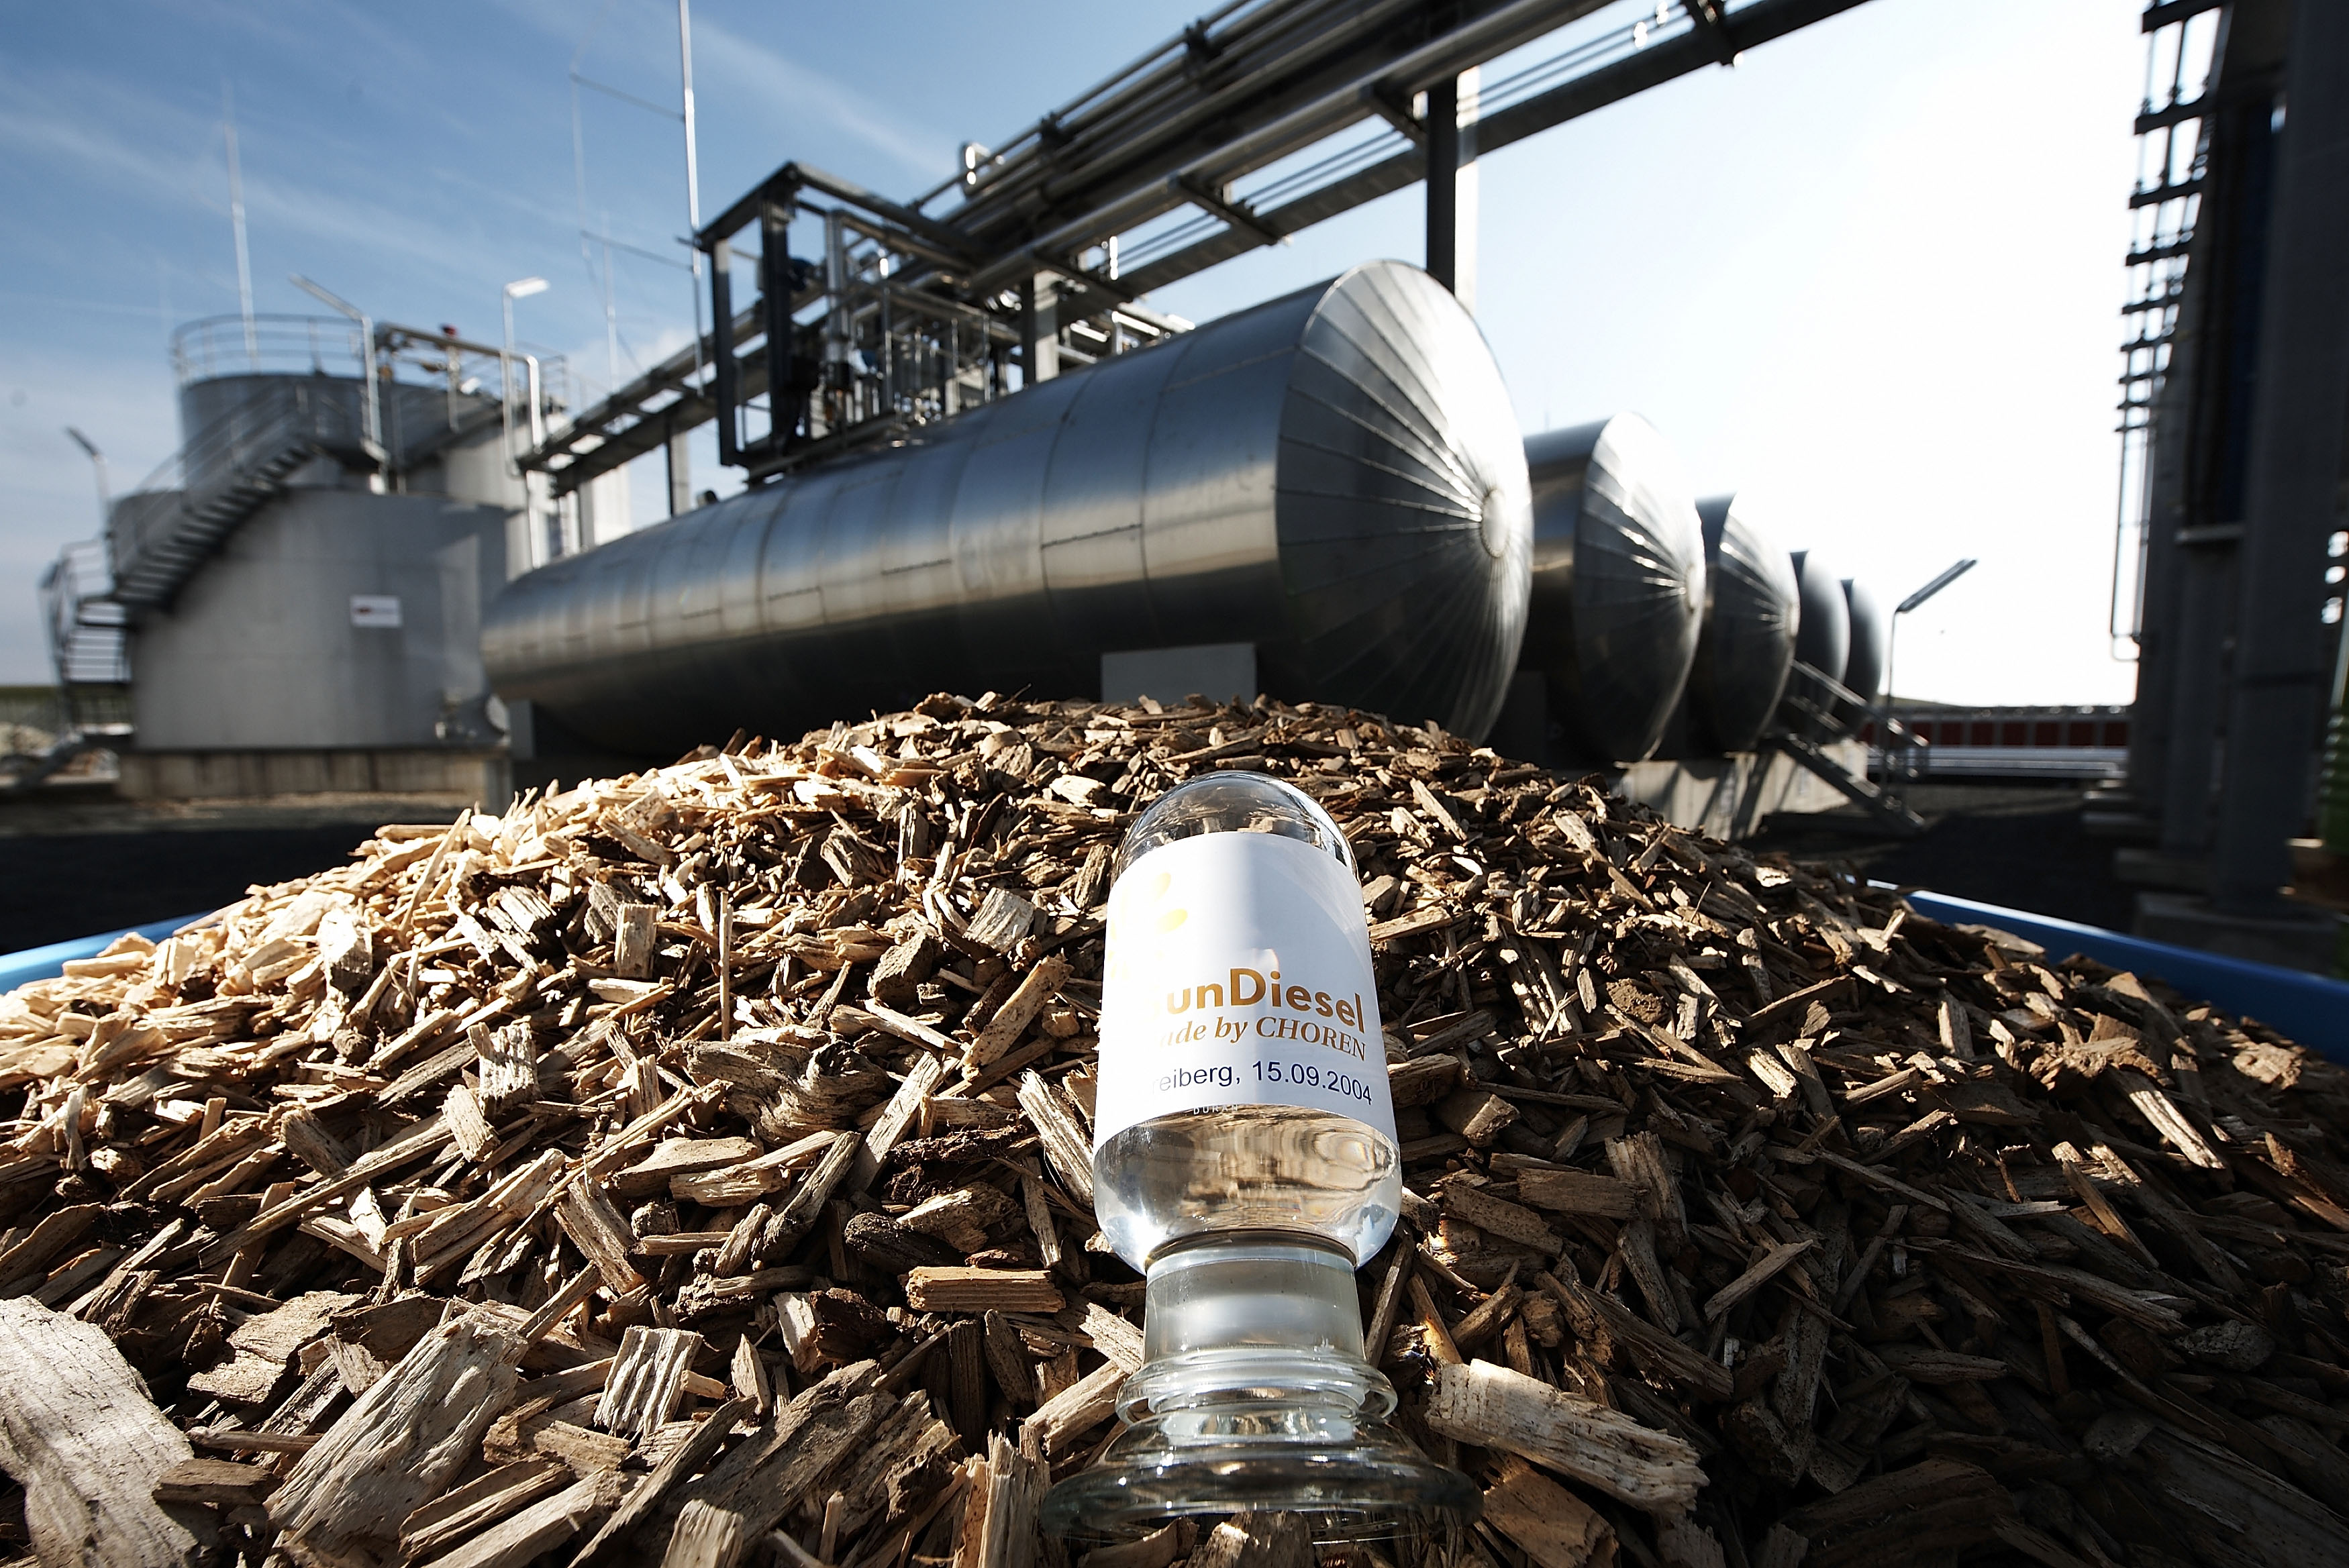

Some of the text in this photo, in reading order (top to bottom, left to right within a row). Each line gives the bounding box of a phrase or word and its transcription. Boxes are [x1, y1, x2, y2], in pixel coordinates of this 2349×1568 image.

[1166, 968, 1365, 1033] unDiesel
[1214, 1016, 1248, 1045] by
[1256, 1016, 1366, 1061] CHOREN
[1252, 1060, 1373, 1106] 15.09.2004
[1193, 1104, 1238, 1115] DURAN
